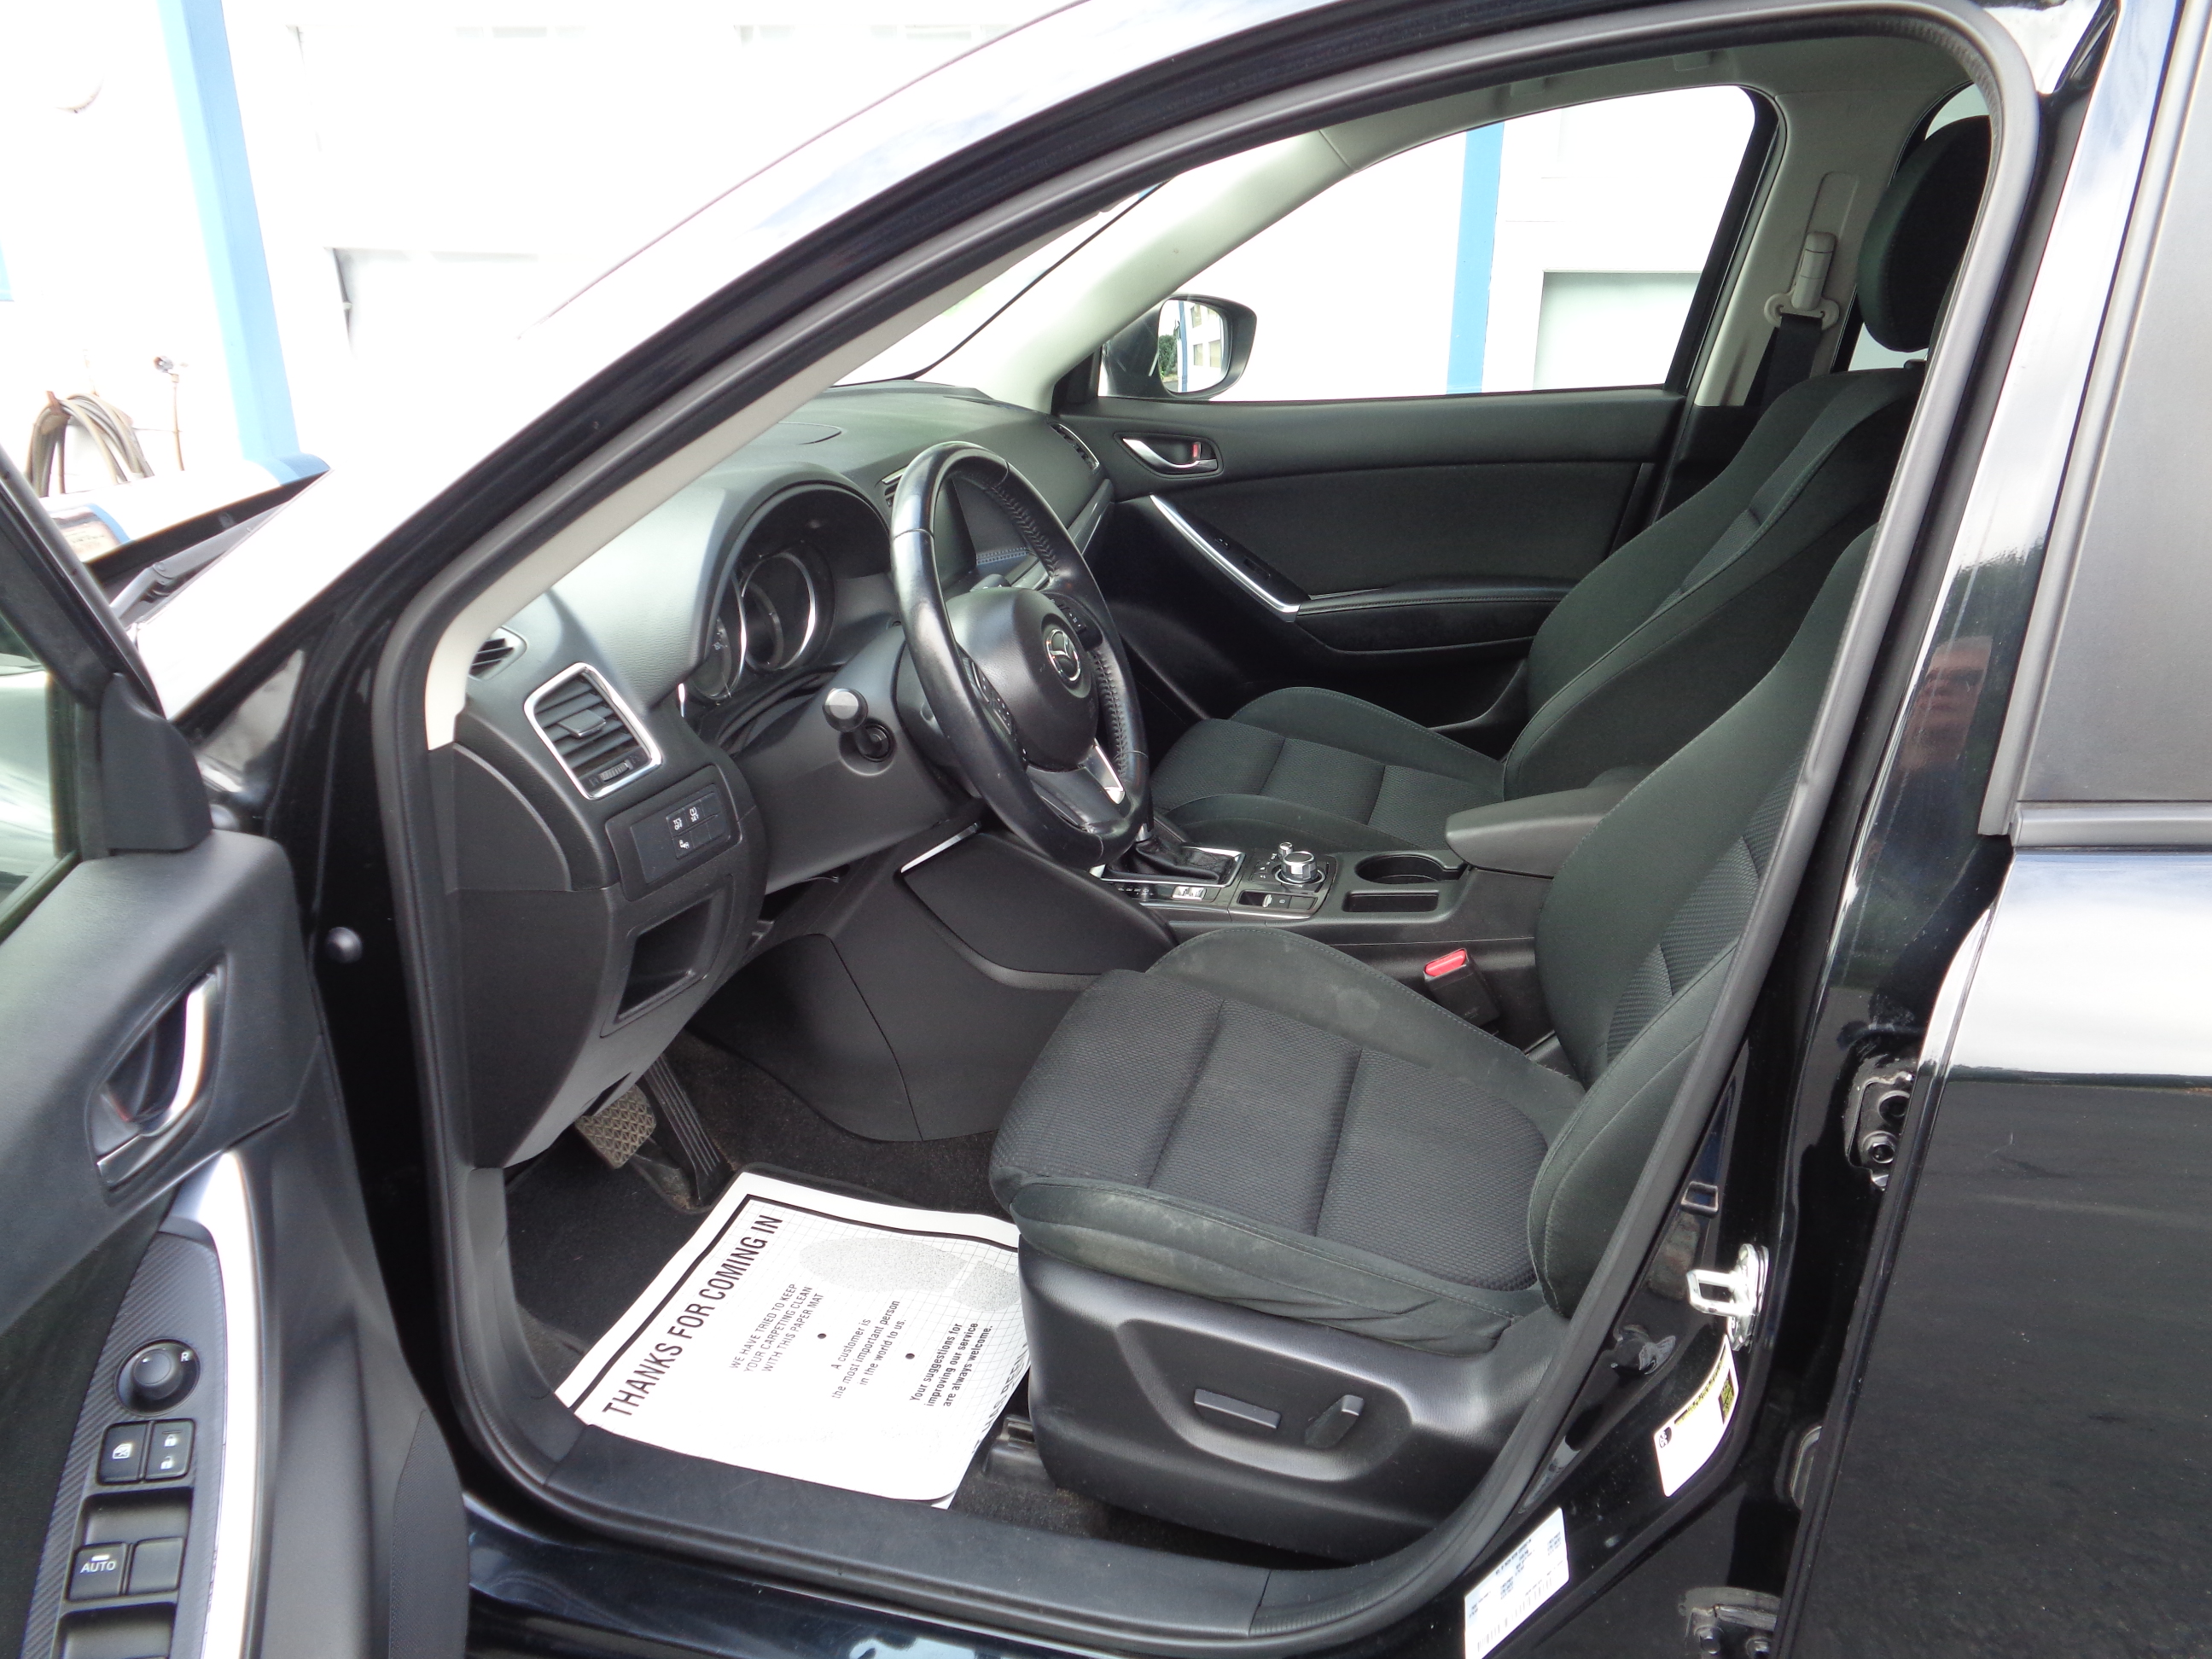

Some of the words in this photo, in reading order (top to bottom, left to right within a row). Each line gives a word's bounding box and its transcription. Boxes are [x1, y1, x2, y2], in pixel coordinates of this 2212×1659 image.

[602, 1342, 684, 1416] THANKS
[667, 1303, 716, 1339] FOR
[698, 1236, 768, 1301] COMING
[750, 1214, 783, 1234] IN
[729, 1356, 745, 1368] WE
[739, 1334, 761, 1355] HAVE
[754, 1313, 777, 1332] TRIED
[771, 1302, 785, 1311] TO
[779, 1284, 798, 1301] KEEP
[743, 1351, 766, 1372] YOUR
[760, 1310, 796, 1349] CARPETING
[790, 1286, 813, 1308] CLEAN
[761, 1351, 783, 1371] WITH
[777, 1333, 796, 1349] THIS
[789, 1309, 813, 1332] PAPER
[806, 1293, 824, 1308] MAT
[831, 1386, 847, 1399] the
[841, 1363, 860, 1384] most
[853, 1326, 884, 1362] important
[879, 1301, 900, 1325] person
[837, 1327, 865, 1362] customer
[857, 1377, 870, 1386] in
[864, 1363, 878, 1376] the
[874, 1339, 893, 1361] world
[886, 1330, 899, 1339] to
[894, 1319, 906, 1330] us.
[180, 1351, 189, 1362] R
[909, 1383, 928, 1400] Your
[923, 1336, 956, 1382] suggestions
[950, 1323, 963, 1335] for
[923, 1366, 957, 1407] improving
[950, 1352, 963, 1365] our
[958, 1323, 979, 1351] service
[943, 1393, 957, 1407] are
[952, 1363, 972, 1391] always
[967, 1325, 993, 1362] welcome.
[80, 1559, 117, 1574] AUTO
